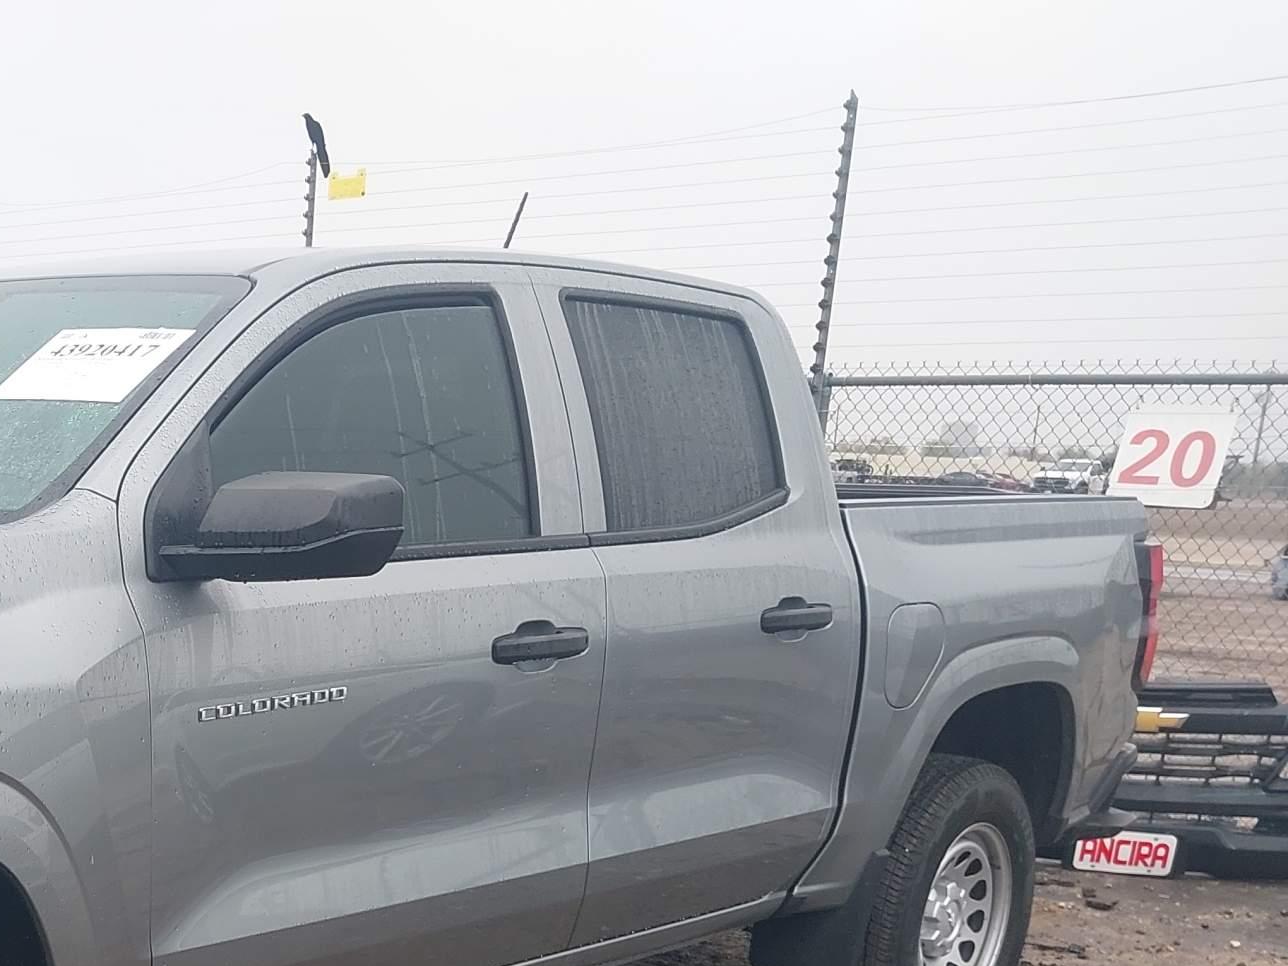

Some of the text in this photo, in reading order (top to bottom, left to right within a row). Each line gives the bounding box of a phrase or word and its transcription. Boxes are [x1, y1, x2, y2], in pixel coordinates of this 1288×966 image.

[50, 343, 160, 357] 43920417
[1117, 428, 1217, 488] 20
[198, 686, 348, 723] COLORADO
[1078, 838, 1170, 869] ANCIRA
